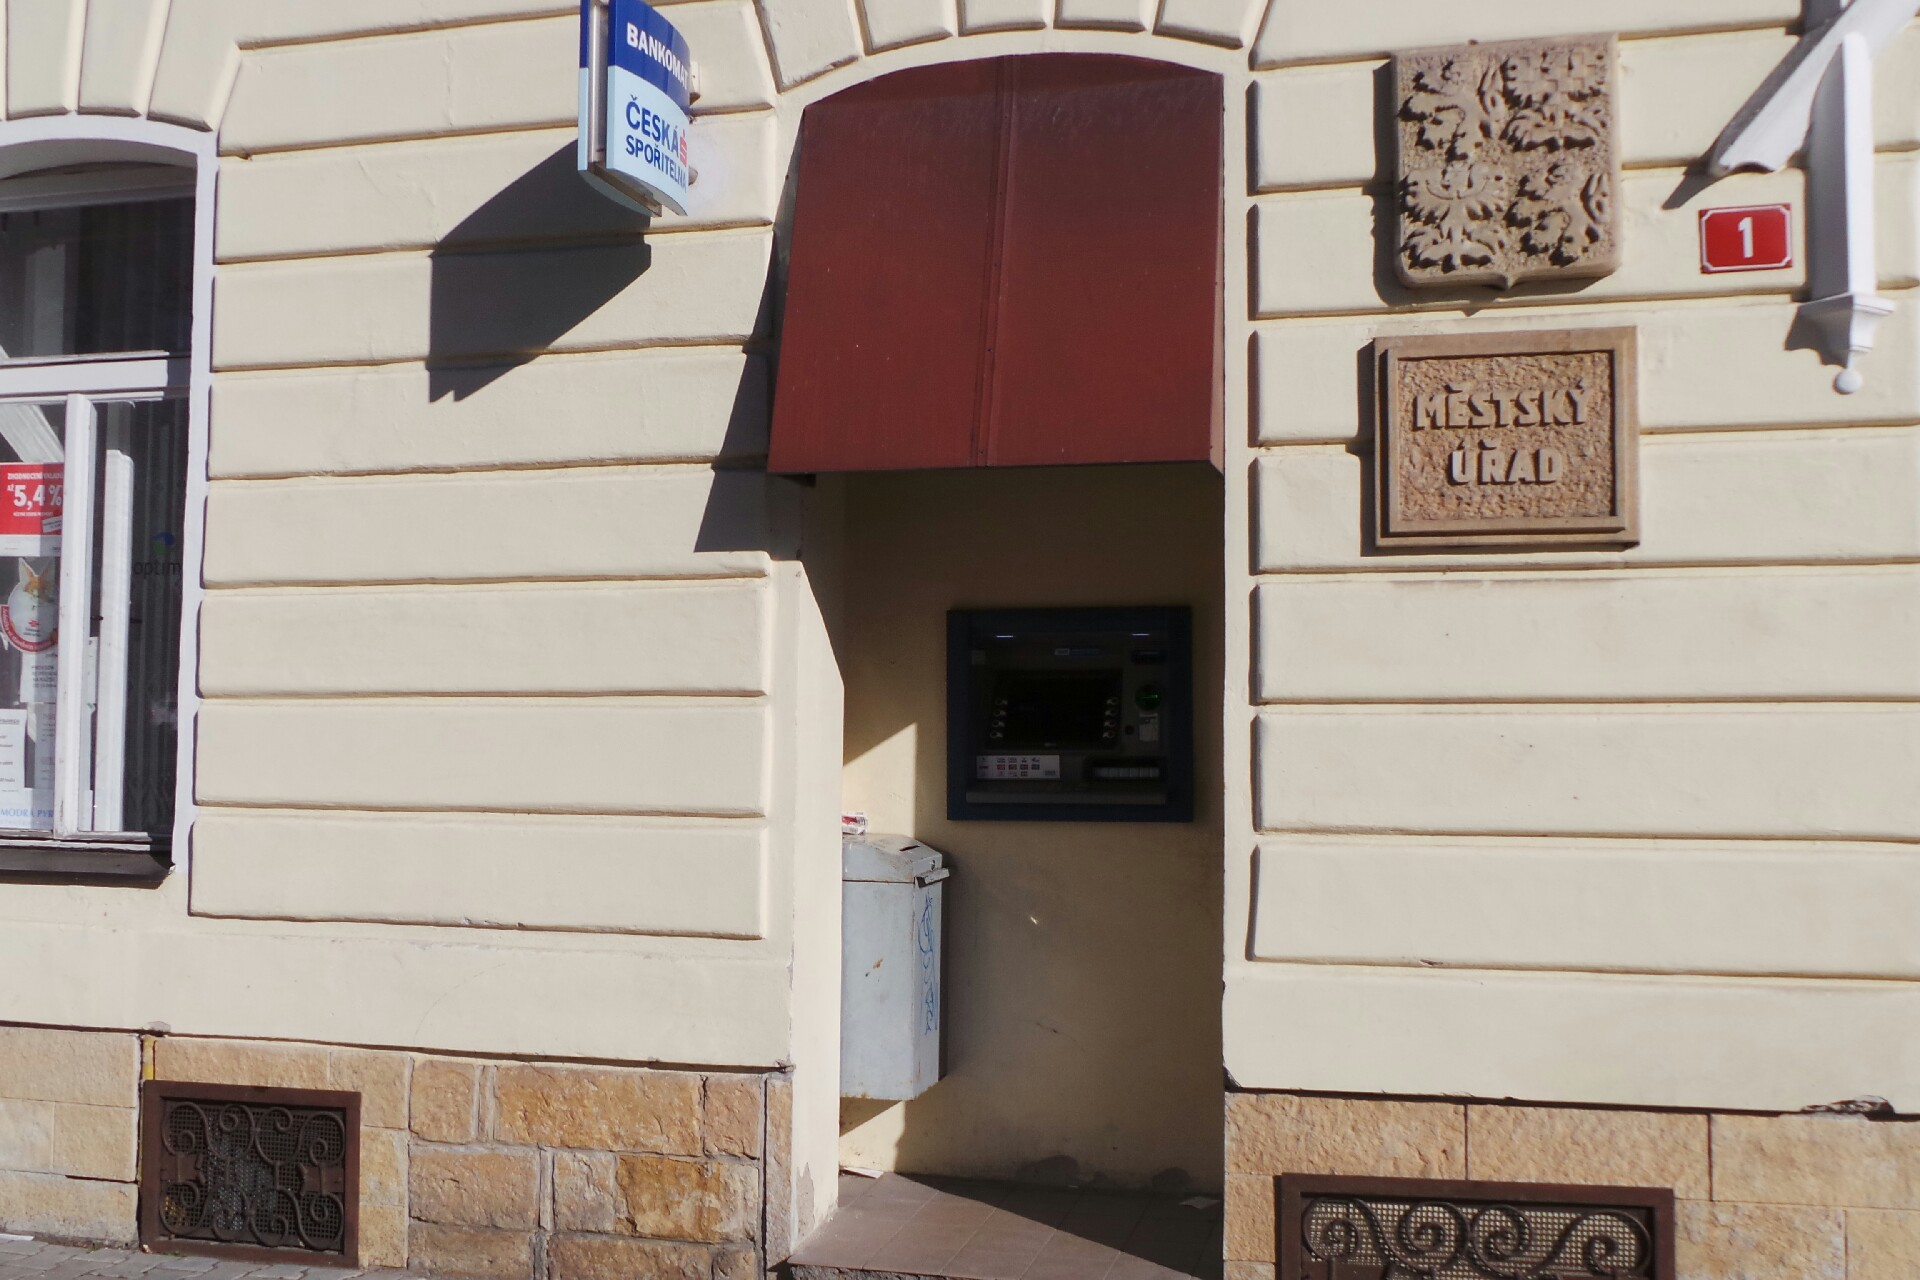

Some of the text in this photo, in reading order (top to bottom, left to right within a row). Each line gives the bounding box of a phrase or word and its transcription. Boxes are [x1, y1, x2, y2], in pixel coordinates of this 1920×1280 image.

[627, 22, 688, 91] BANKOMAT
[626, 94, 679, 158] ČESKÁ
[626, 134, 687, 194] SPOŘITELNA
[1737, 216, 1754, 259] 1
[1412, 379, 1590, 431] MĚSTSKÝ
[1447, 439, 1563, 485] ÚŘAD
